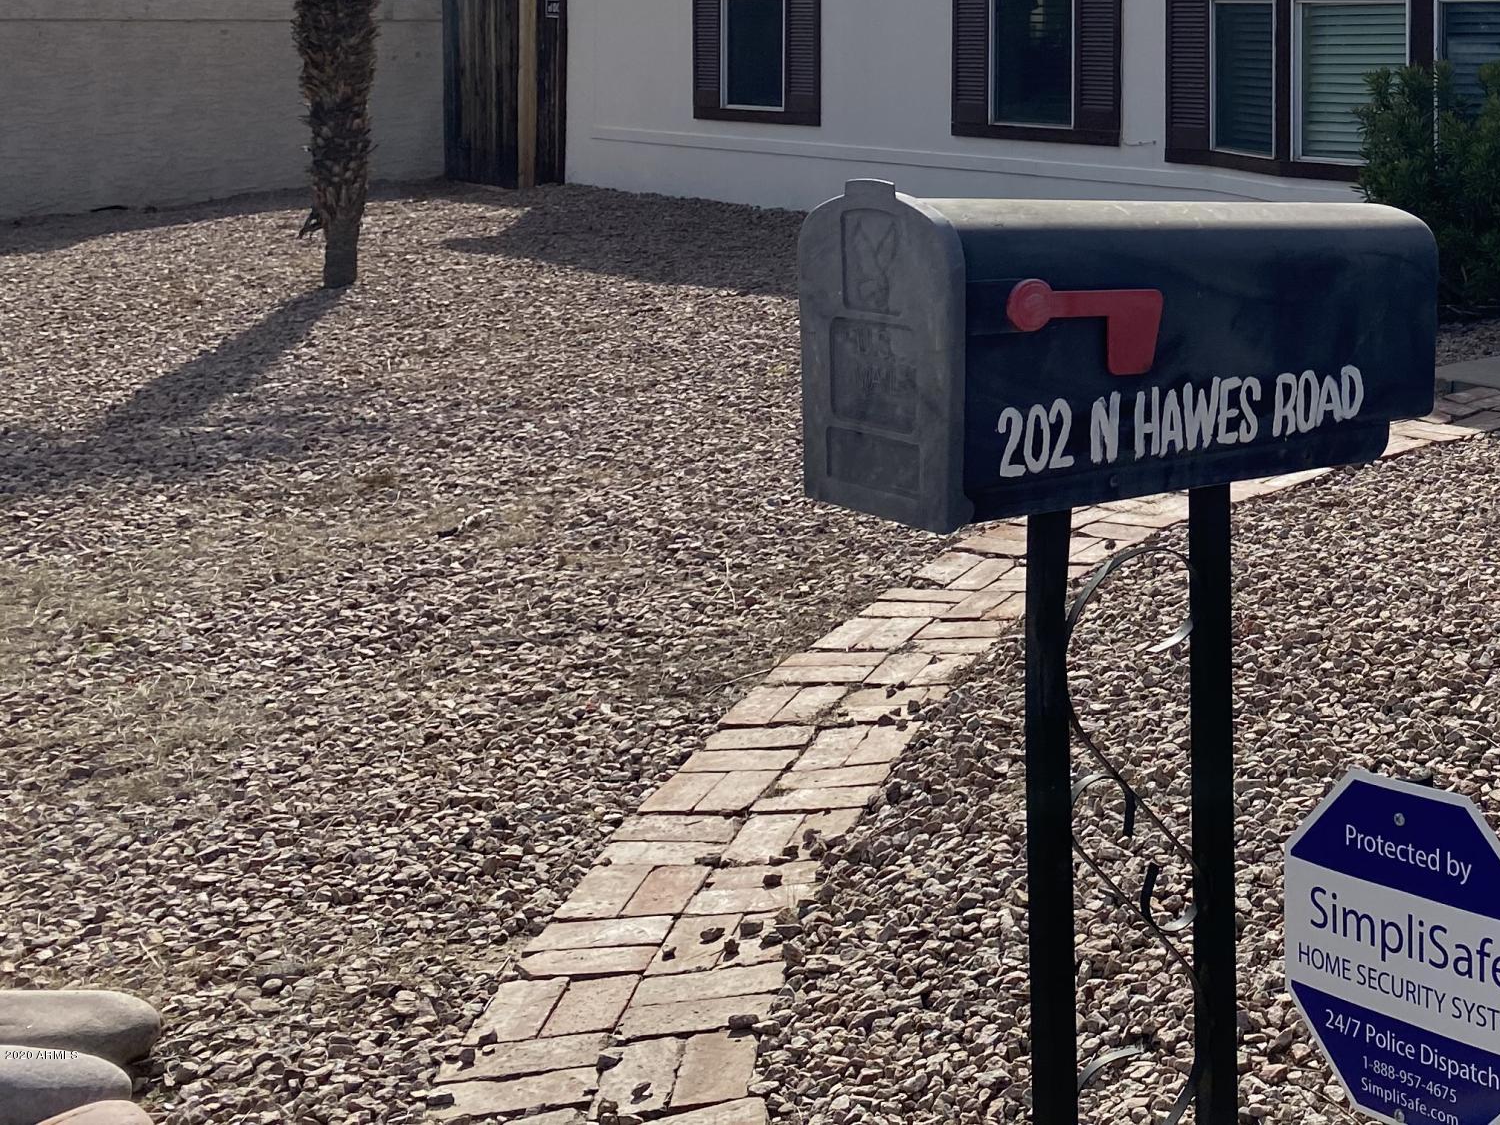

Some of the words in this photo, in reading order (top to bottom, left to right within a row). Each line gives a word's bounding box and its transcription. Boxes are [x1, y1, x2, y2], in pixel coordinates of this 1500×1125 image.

[998, 398, 1074, 478] 202
[1090, 391, 1121, 464] N
[1134, 376, 1262, 461] HAWES
[1272, 364, 1364, 437] ROAD
[1345, 824, 1440, 872] Protected
[1447, 852, 1472, 885] by
[1298, 941, 1351, 982] HOME
[1356, 964, 1446, 1014] SECURITY
[1325, 1009, 1361, 1038] 24/7
[1366, 1022, 1416, 1060] Police
[1420, 1043, 1500, 1091] Dispatch
[1362, 1055, 1457, 1104] 1-888-957-4675
[1361, 1076, 1459, 1125] SimpliSafe.com
